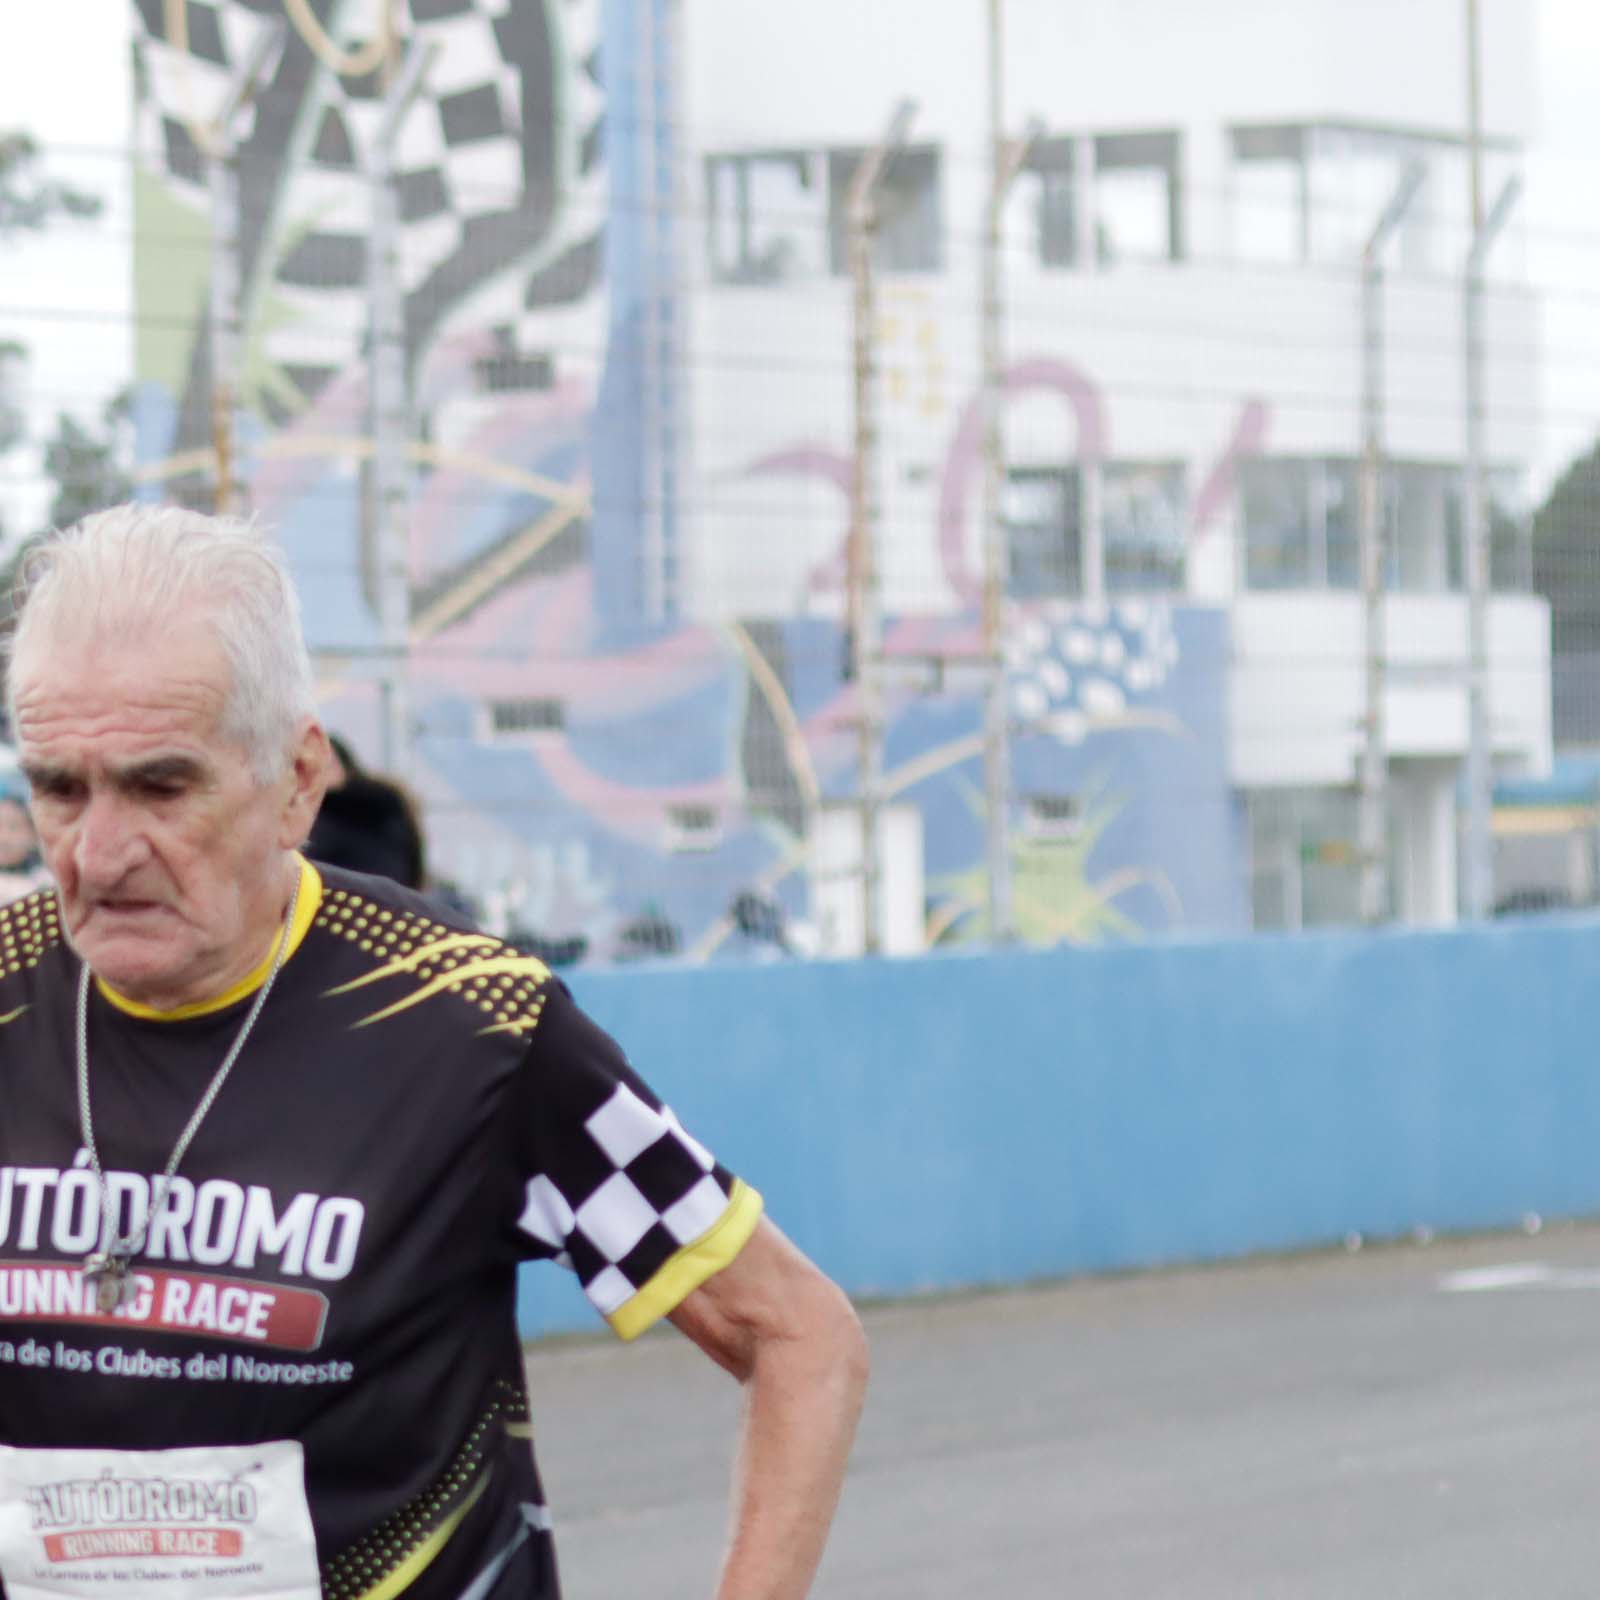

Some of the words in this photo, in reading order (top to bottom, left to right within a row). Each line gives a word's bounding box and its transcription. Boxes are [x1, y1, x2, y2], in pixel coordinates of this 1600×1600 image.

[161, 1277, 277, 1340] RACE
[18, 1338, 50, 1367] de
[55, 1341, 93, 1372] los
[97, 1346, 181, 1378] Clubes
[185, 1352, 228, 1380] del
[232, 1355, 354, 1384] Noroeste
[31, 1468, 257, 1529] AUTÓDROMO
[64, 1530, 154, 1557] RUNNING
[159, 1529, 217, 1552] RACE
